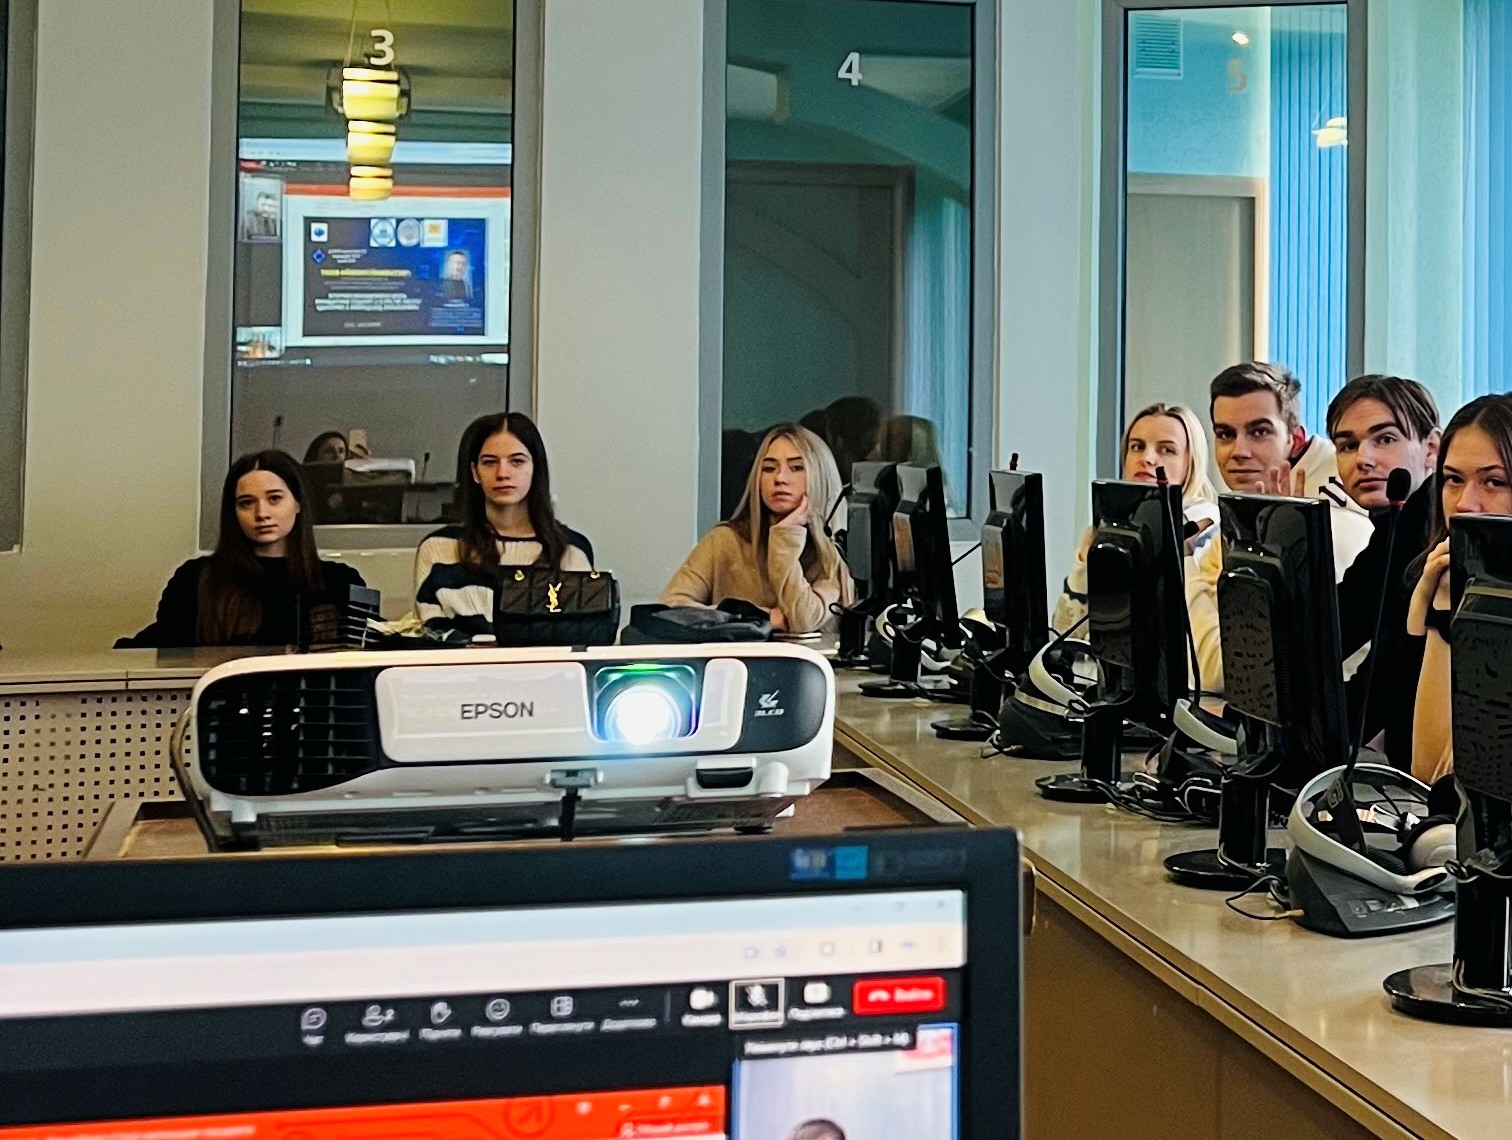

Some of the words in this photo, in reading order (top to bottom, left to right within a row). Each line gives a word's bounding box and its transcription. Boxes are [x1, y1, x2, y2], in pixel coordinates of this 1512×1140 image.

[370, 28, 394, 65] 3
[837, 51, 863, 86] 4
[460, 701, 534, 720] EPSON
